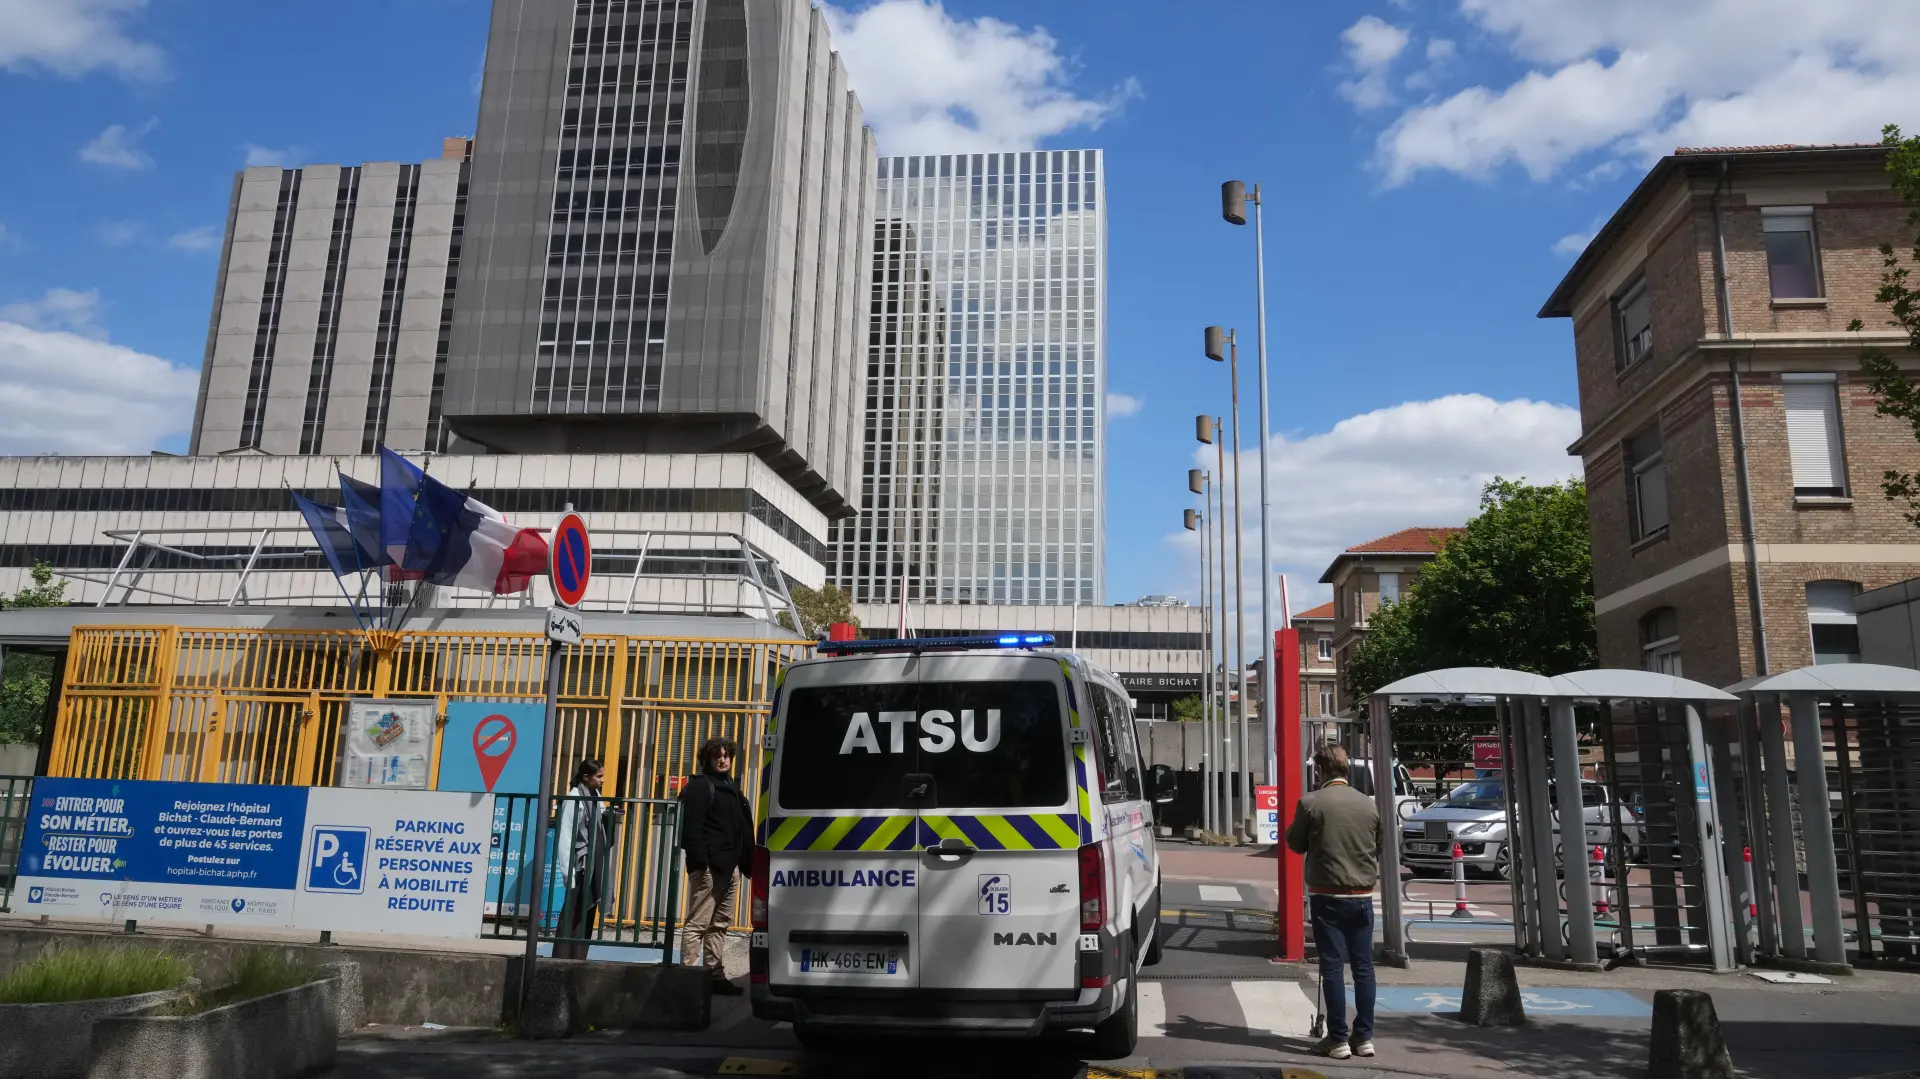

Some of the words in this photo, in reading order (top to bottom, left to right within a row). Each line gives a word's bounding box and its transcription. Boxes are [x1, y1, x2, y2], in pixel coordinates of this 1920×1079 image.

[839, 709, 1001, 754] ATSU
[55, 797, 94, 812] ENTRER
[95, 798, 124, 813] POUR
[174, 800, 225, 812] Rejoignez
[227, 802, 270, 814] l'hôpital
[40, 814, 72, 830] SON
[74, 813, 131, 835] MÉTIER,
[159, 812, 192, 822] Bichat
[200, 814, 282, 826] Claude-Bernard
[395, 820, 465, 834] PARKING
[493, 820, 523, 832] ôpta
[154, 825, 165, 834] et
[167, 827, 229, 837] ouvrez-vous
[232, 828, 246, 837] les
[248, 830, 282, 840] portes
[48, 836, 87, 852] RESTER
[87, 838, 117, 853] POUR
[160, 837, 172, 847] de
[174, 838, 196, 849] plus
[199, 839, 212, 849] de
[214, 840, 227, 849] 45
[229, 841, 273, 851] services.
[315, 833, 339, 868] P
[375, 836, 444, 853] RÉSERVÉ
[448, 842, 481, 854] AUX
[43, 851, 115, 873] ÉVOLUER.
[188, 855, 224, 864] Postulez
[490, 849, 527, 860] eidr
[167, 866, 257, 880] hopital-bichat.aphp.fr
[378, 858, 473, 874] PERSONNES
[378, 874, 389, 889] À
[394, 878, 469, 893] MOBILITÉ
[772, 869, 916, 887] AMBULANCE
[388, 894, 455, 912] RÉDUITE
[985, 893, 1008, 913] 15
[994, 932, 1056, 946] MAN
[812, 950, 885, 969] HK-466-EN
